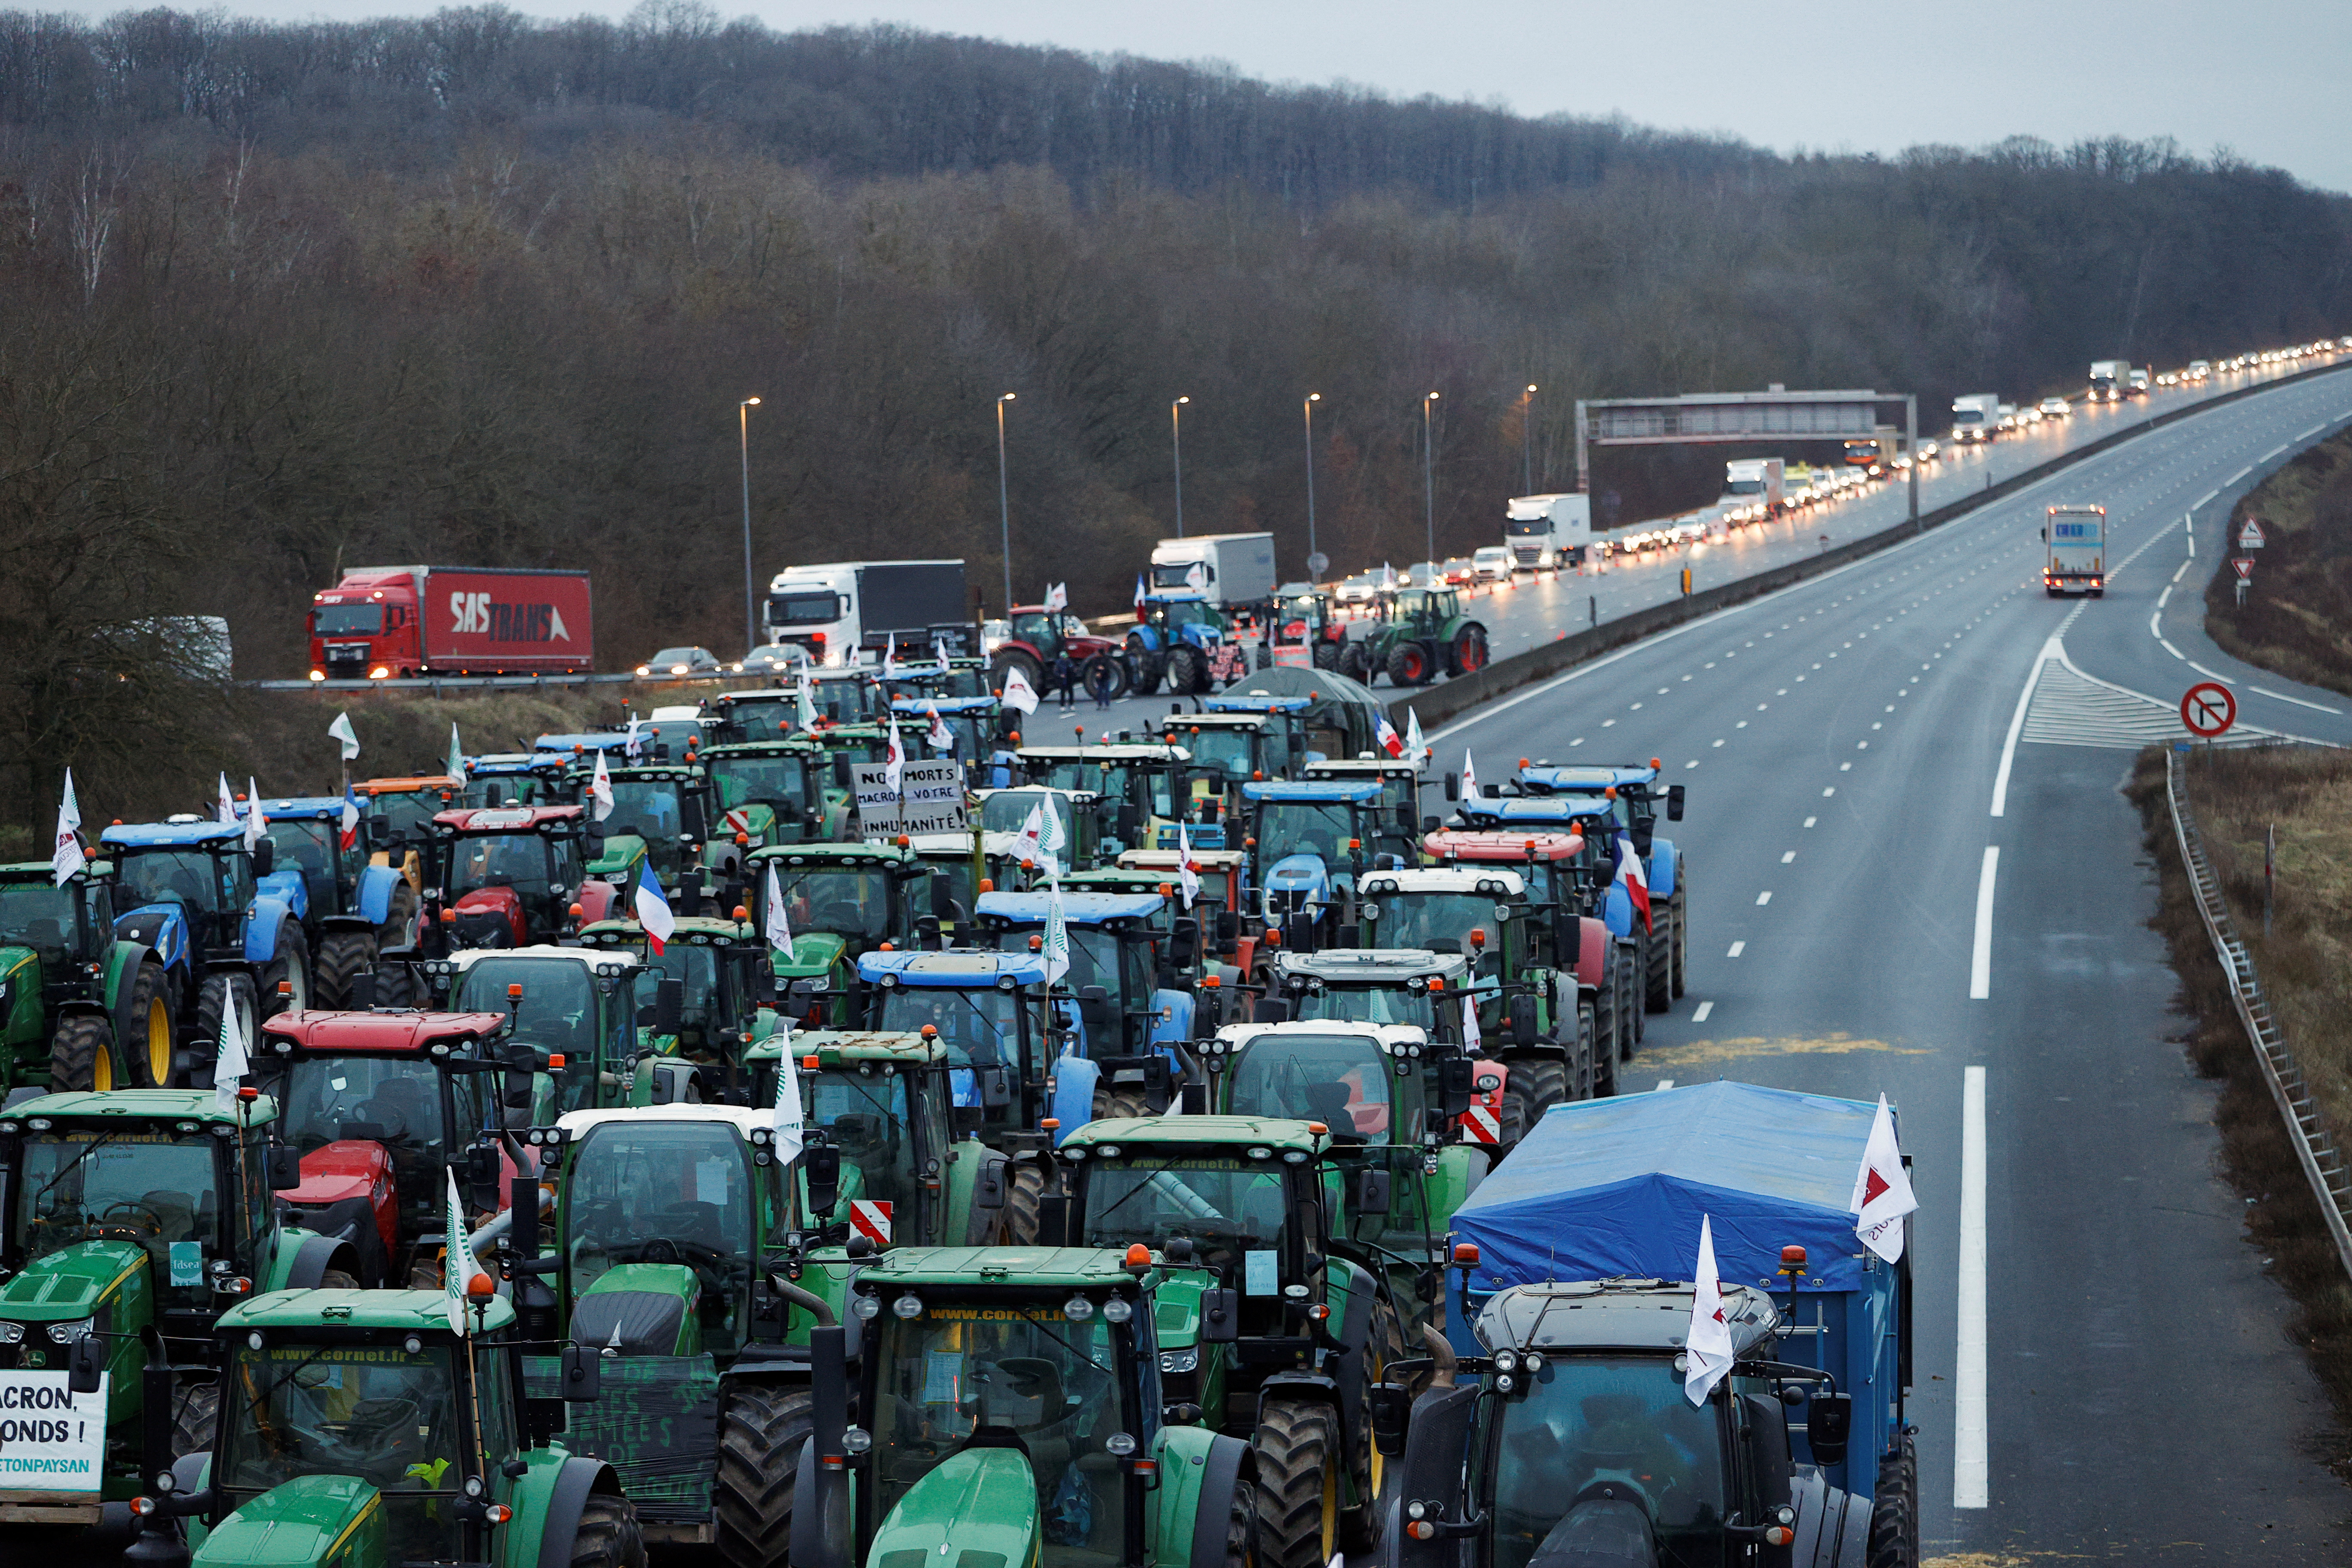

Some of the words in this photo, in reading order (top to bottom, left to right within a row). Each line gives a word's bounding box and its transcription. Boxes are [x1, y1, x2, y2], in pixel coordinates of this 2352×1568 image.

[450, 591, 491, 634] SAS
[489, 603, 553, 642] TRANS
[904, 769, 954, 781] MORTS
[914, 787, 954, 799] VOTRE
[0, 1386, 77, 1412] CRON,
[0, 1459, 89, 1473] TONPAYSAN
